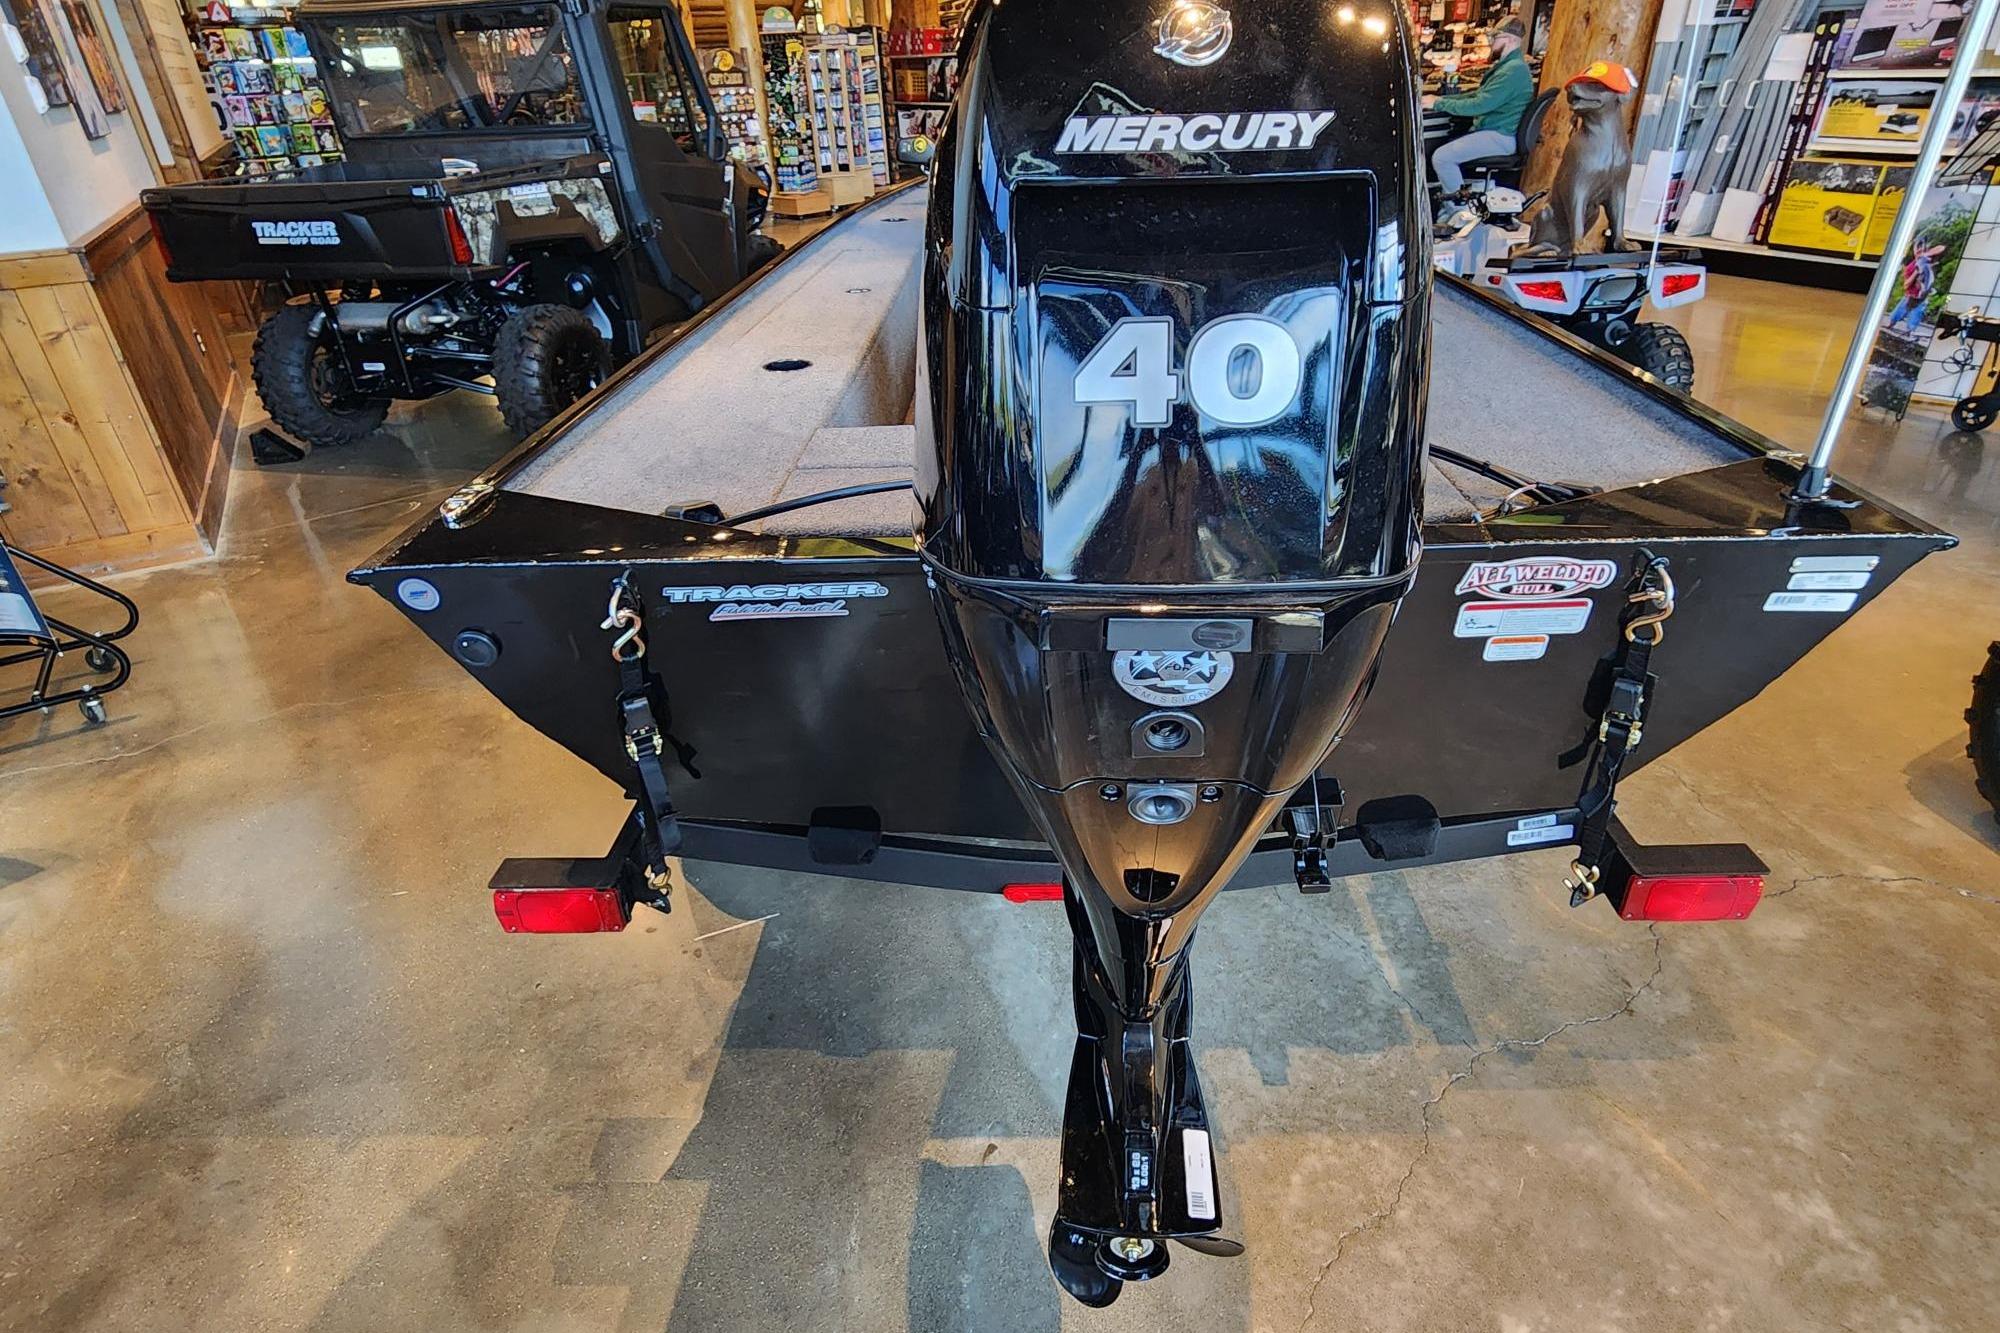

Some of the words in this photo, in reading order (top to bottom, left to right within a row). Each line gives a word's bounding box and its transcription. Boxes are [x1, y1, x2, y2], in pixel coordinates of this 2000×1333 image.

[1055, 110, 1336, 152] MERCURY
[252, 221, 338, 237] TRACKER
[1073, 316, 1301, 427] 40
[1461, 566, 1511, 590] ALL
[1516, 564, 1610, 586] WELDED
[1510, 584, 1554, 595] HULL
